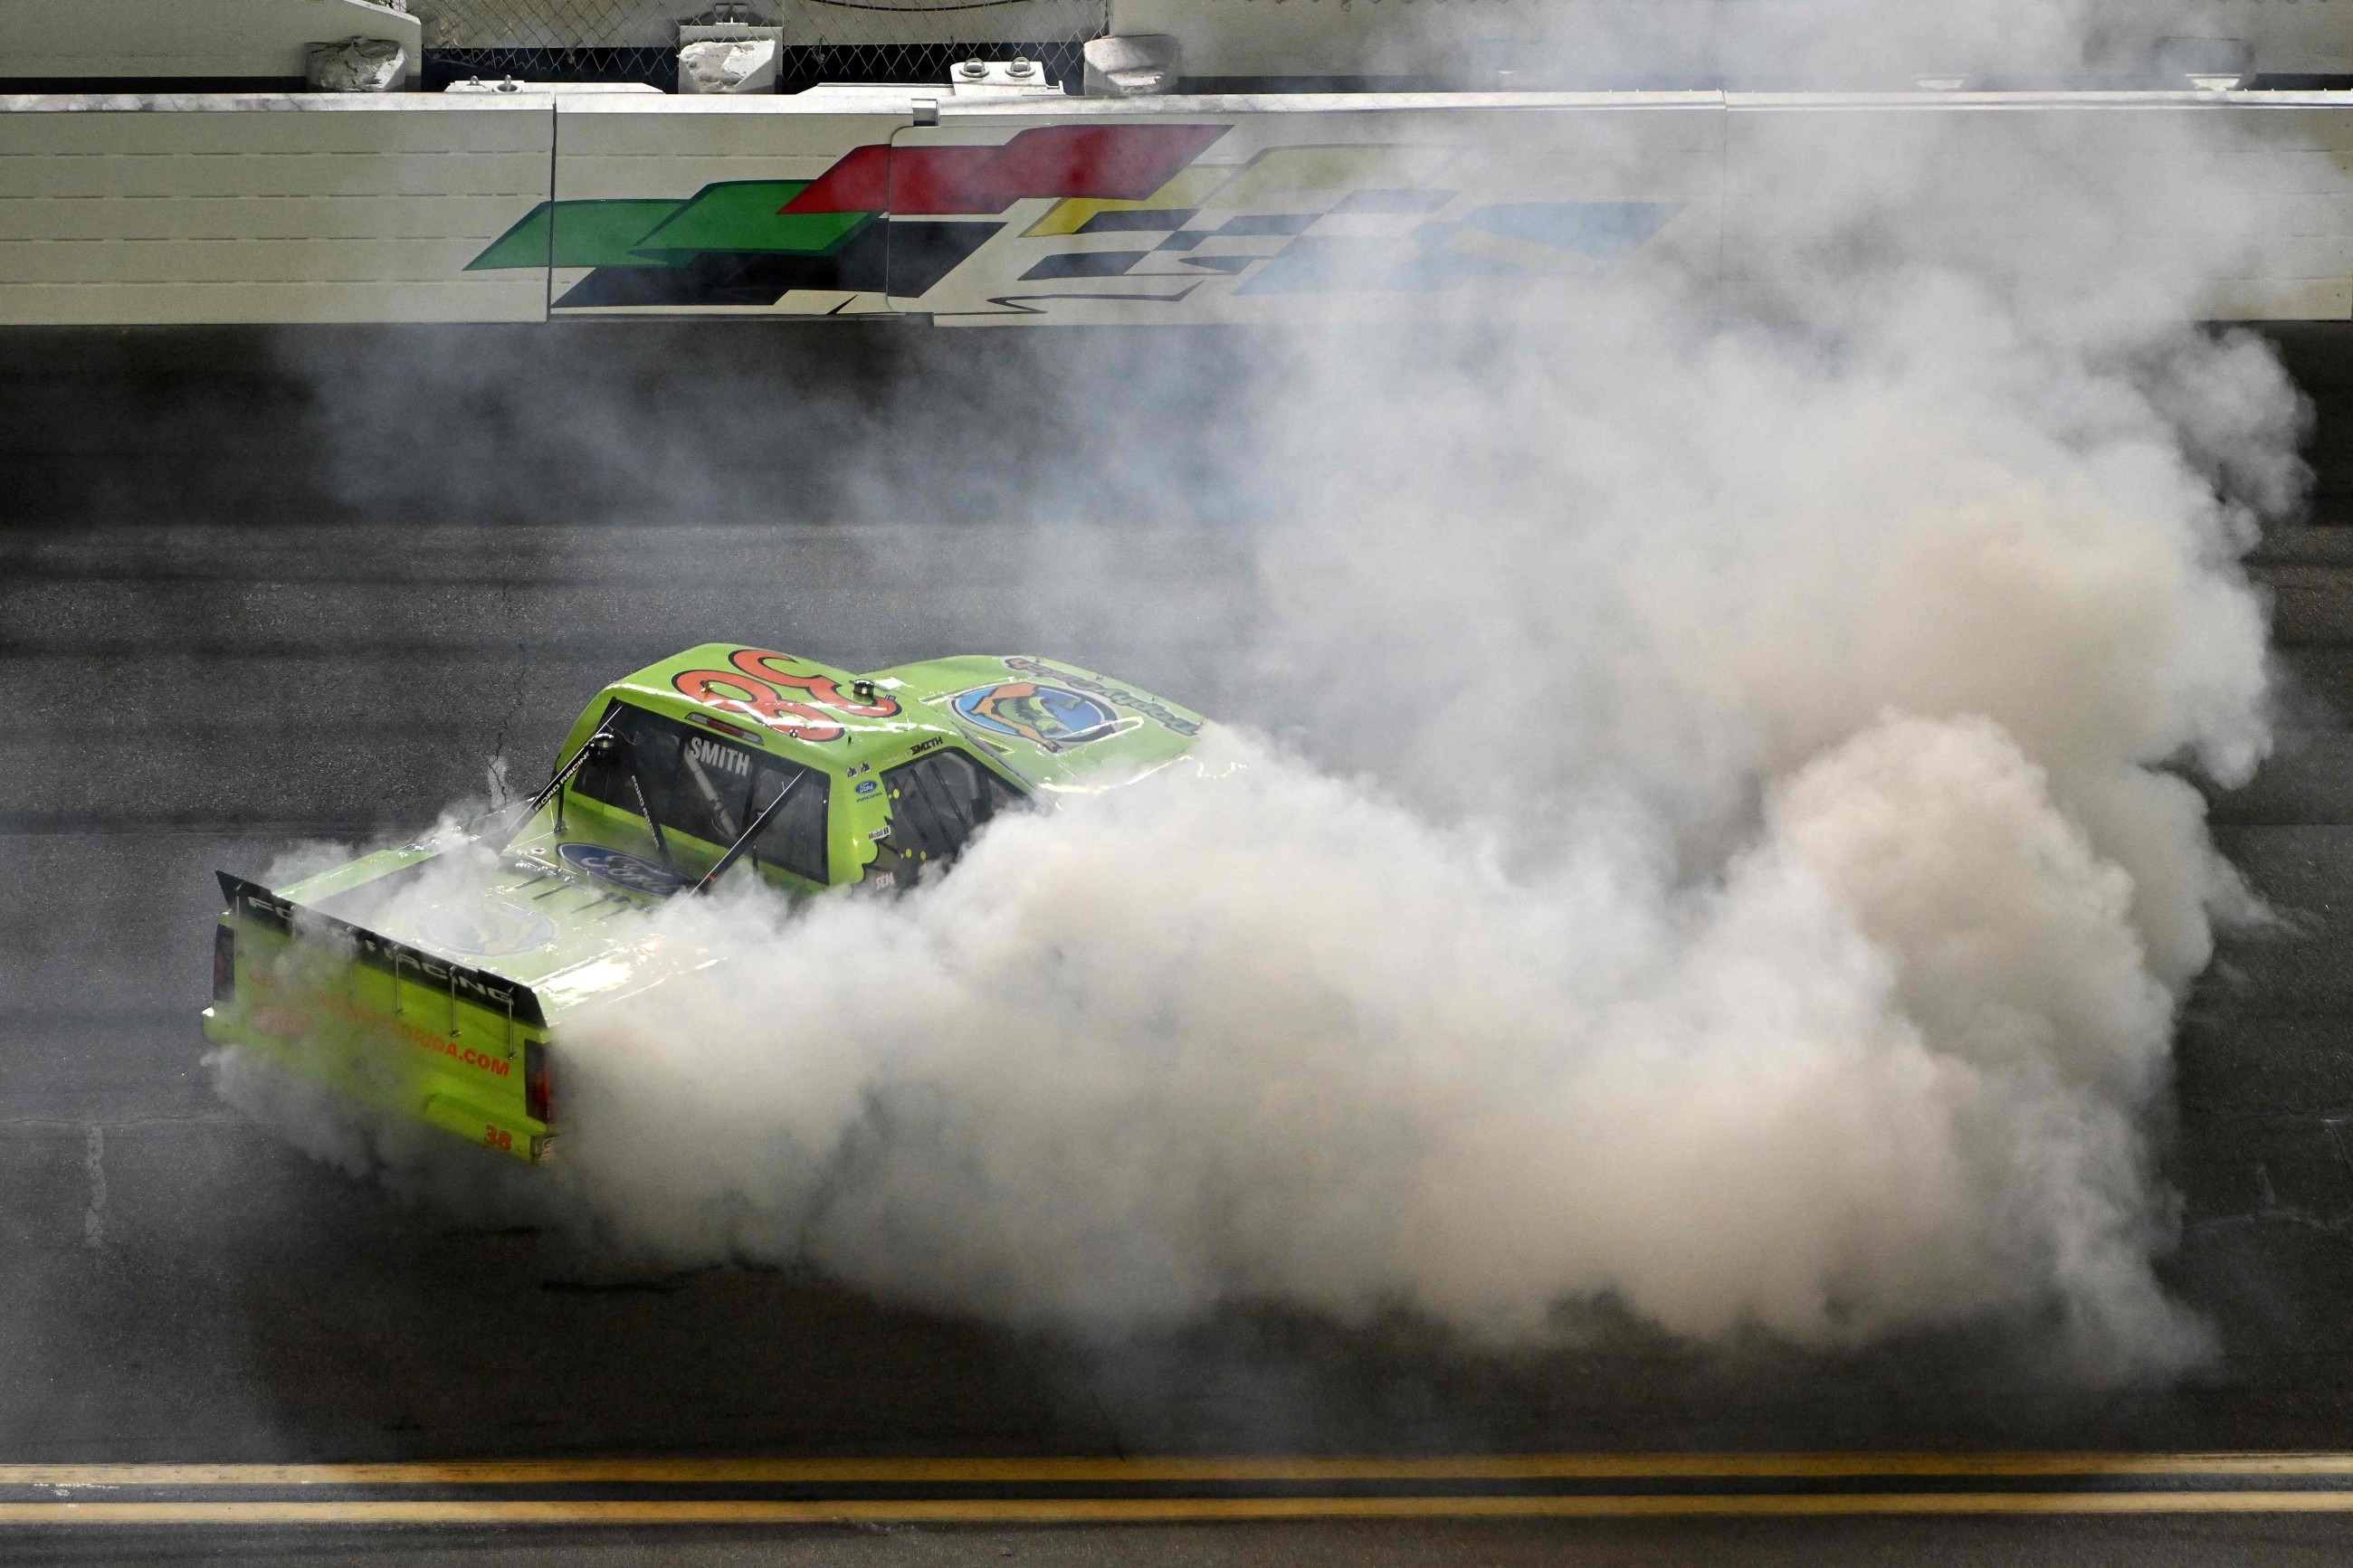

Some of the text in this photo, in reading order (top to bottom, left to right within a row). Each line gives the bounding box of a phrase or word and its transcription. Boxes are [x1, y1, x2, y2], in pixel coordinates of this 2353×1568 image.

[672, 649, 902, 742] 38
[691, 736, 750, 777] SMITH
[910, 736, 944, 755] SMITH
[534, 784, 561, 813] FORD
[631, 774, 645, 807] FORD
[856, 791, 883, 803] RACING
[859, 782, 874, 794] Ford
[868, 828, 884, 841] Mobil
[875, 871, 895, 890] SEM
[483, 1124, 512, 1152] 38
